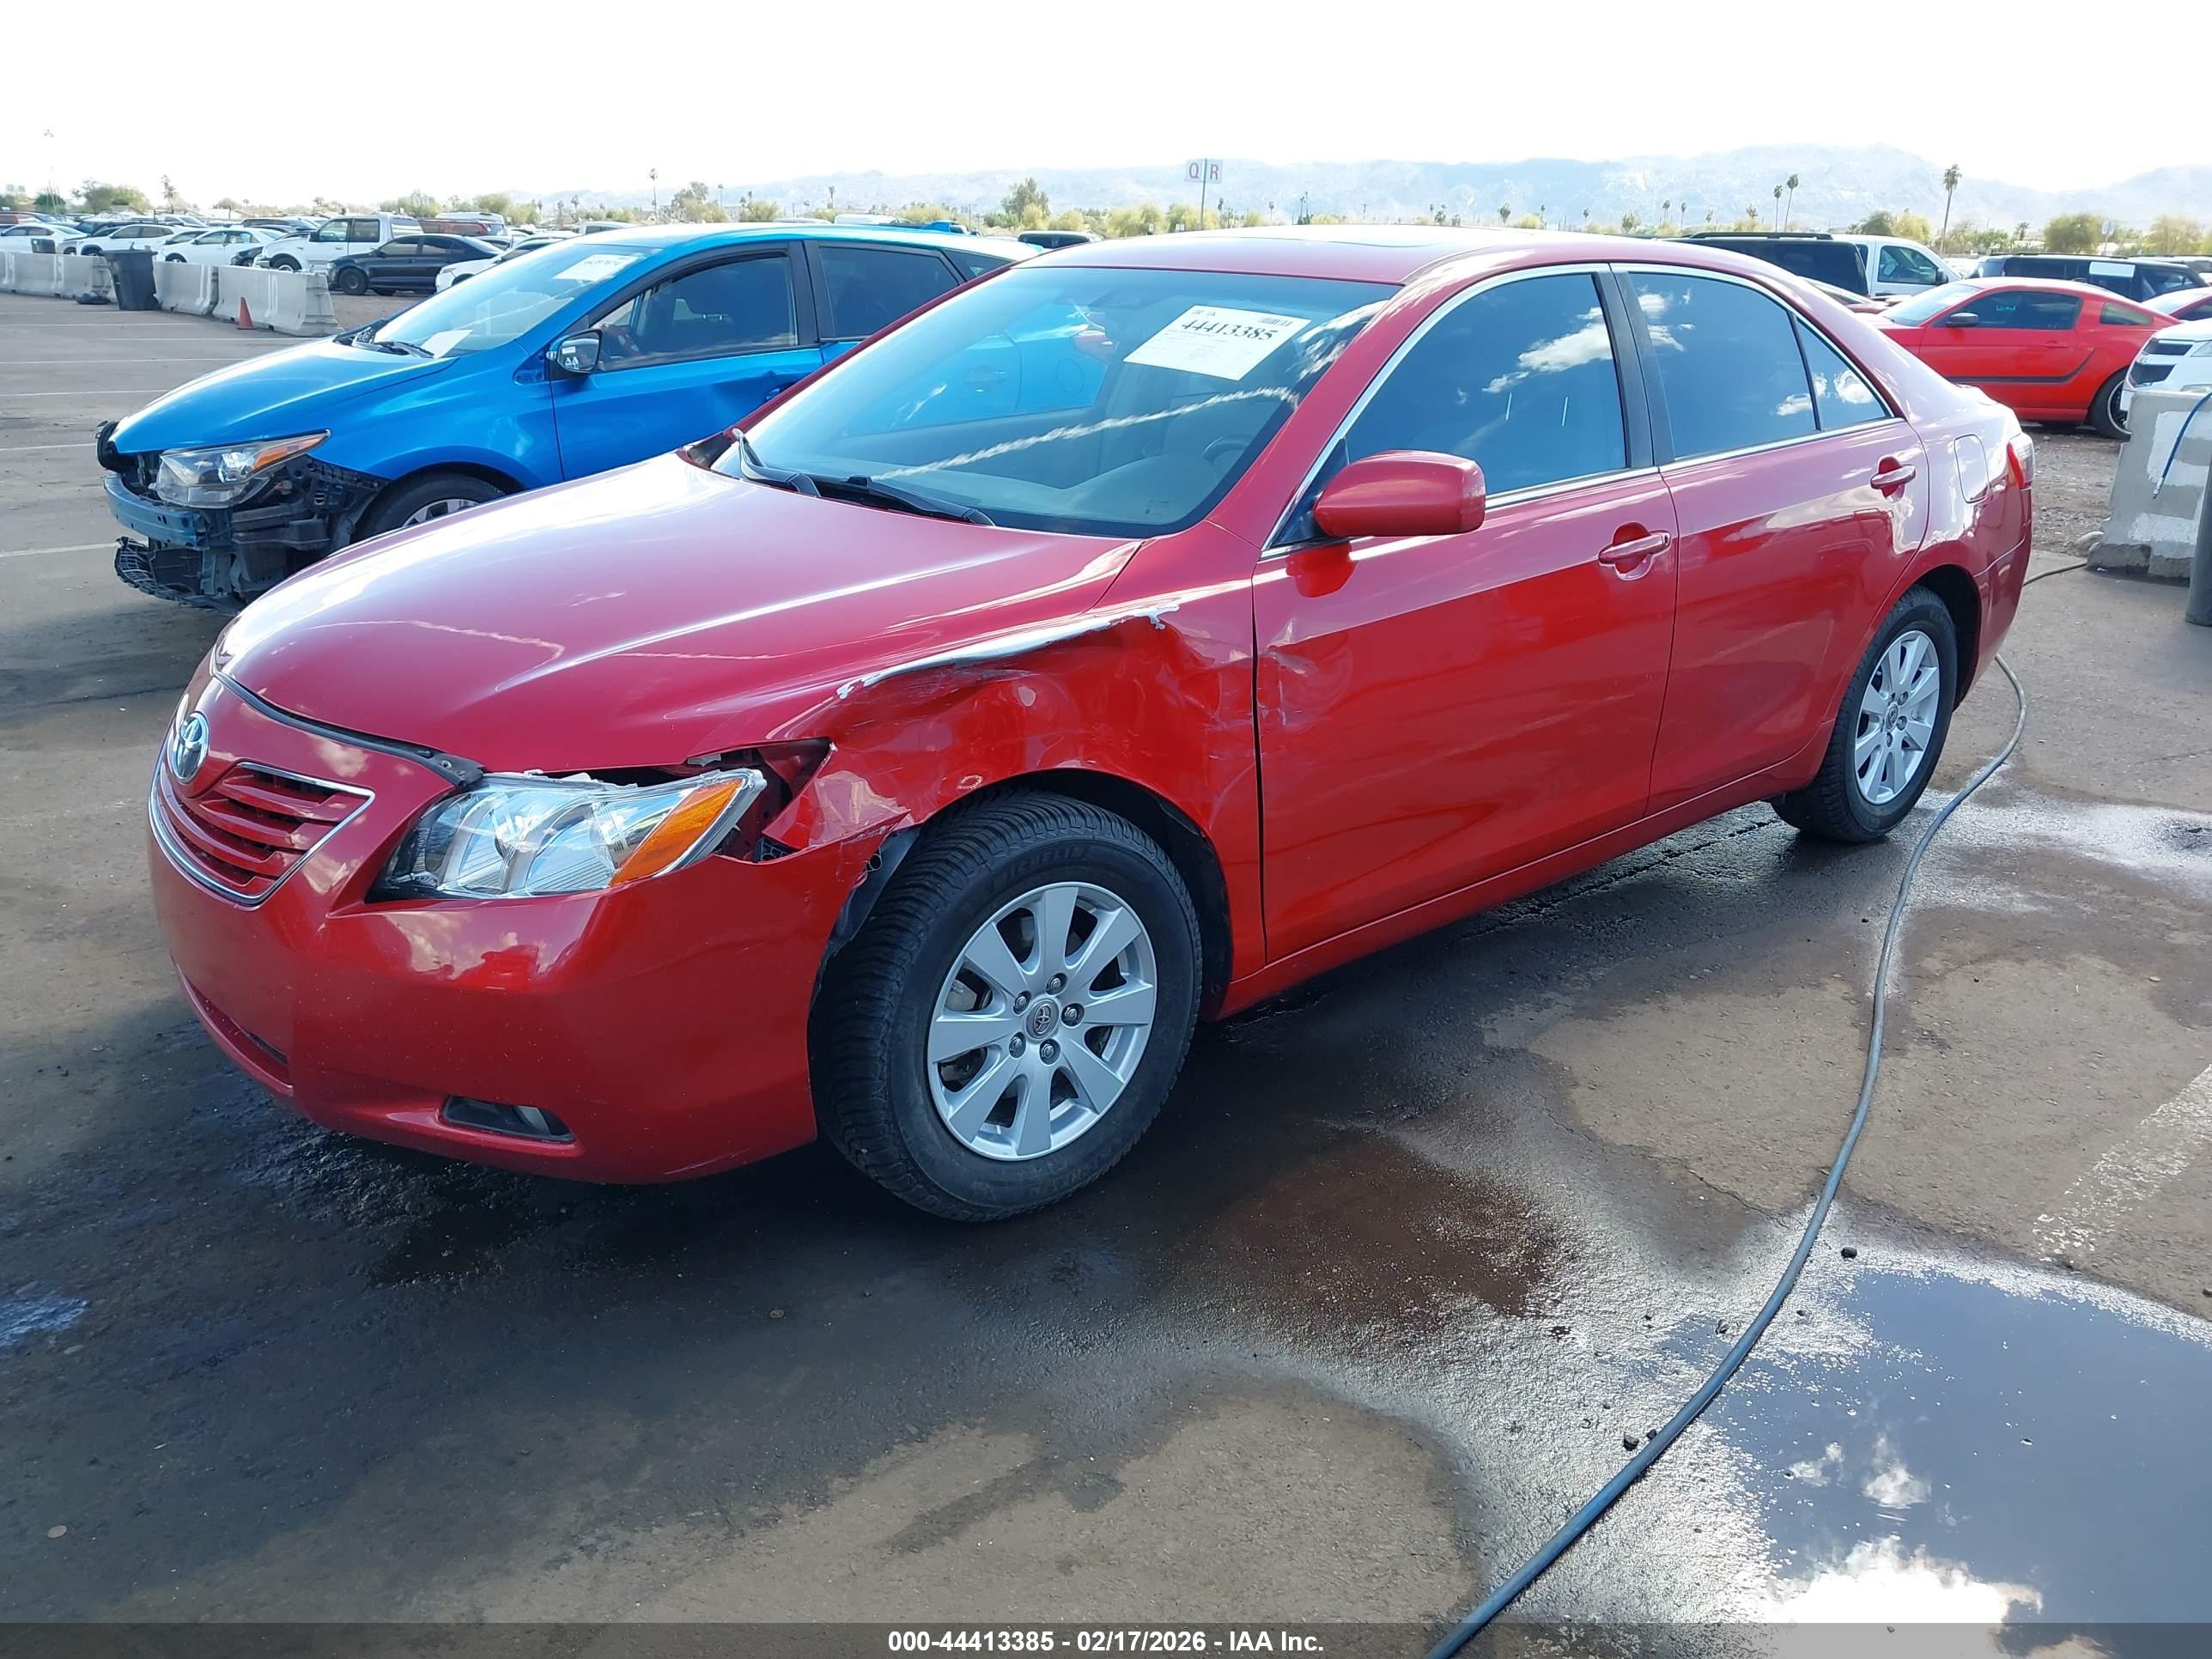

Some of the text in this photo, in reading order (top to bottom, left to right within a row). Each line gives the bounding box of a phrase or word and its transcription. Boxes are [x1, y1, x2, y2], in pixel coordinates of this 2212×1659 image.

[1188, 162, 1200, 179] Q
[1209, 164, 1219, 180] R
[1181, 319, 1279, 341] 44413385
